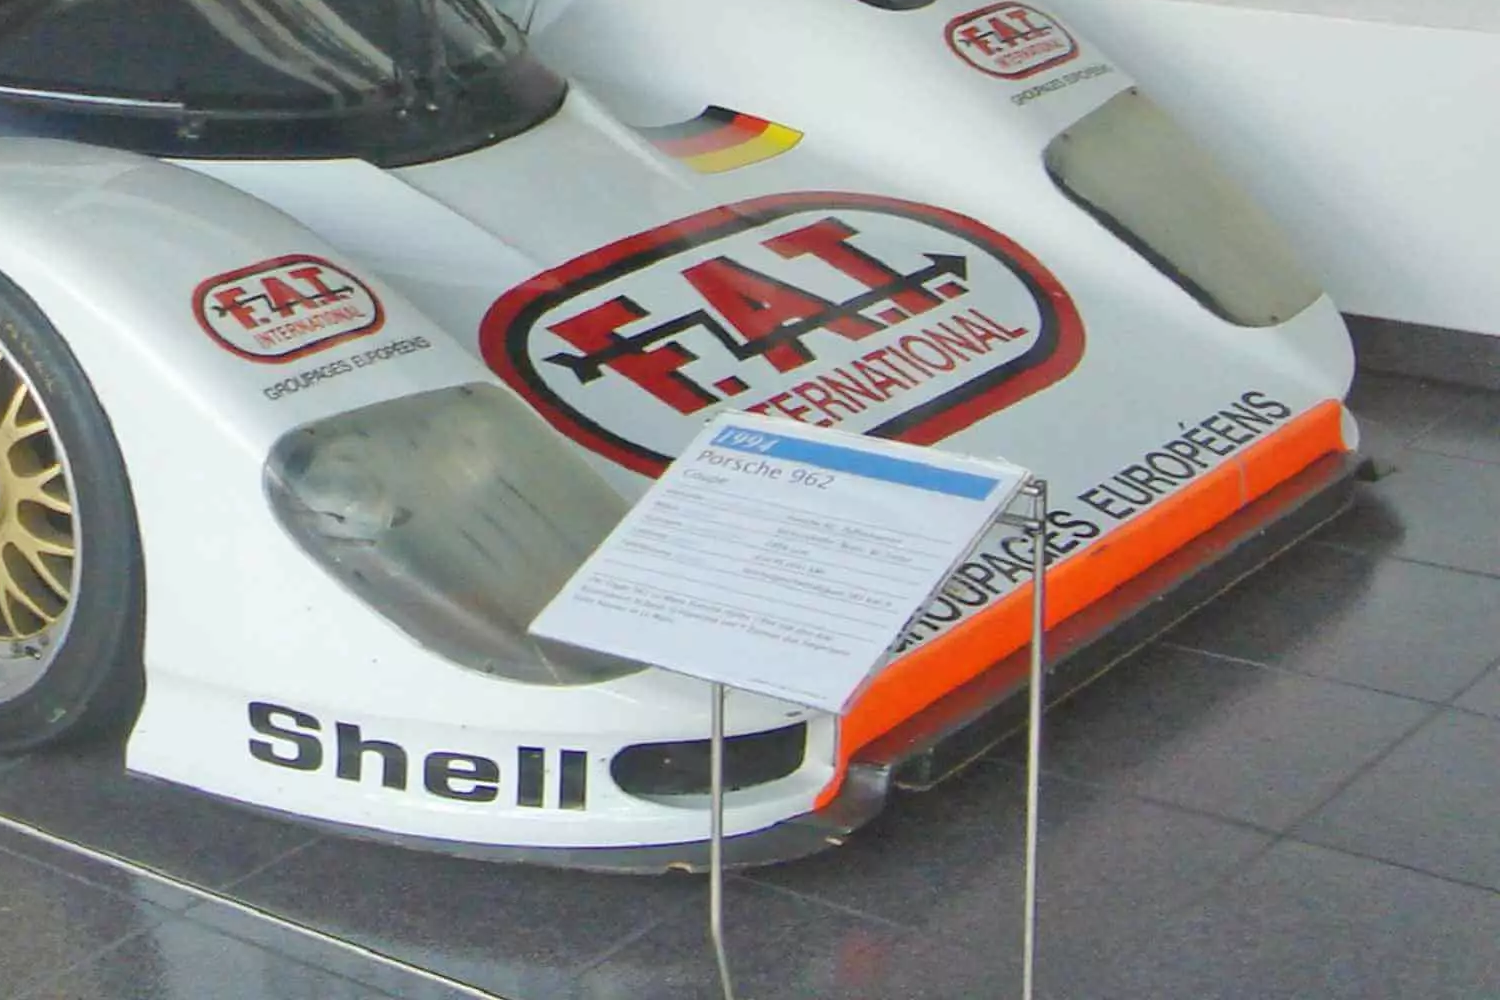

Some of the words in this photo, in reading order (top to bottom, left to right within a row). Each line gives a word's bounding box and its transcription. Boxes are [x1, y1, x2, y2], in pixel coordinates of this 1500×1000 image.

[253, 304, 367, 350] INTERNATIONAL
[263, 359, 353, 401] GROUPAGES
[713, 426, 778, 453] 1994
[1078, 391, 1292, 520] EUROPÉENS
[696, 449, 784, 481] Porsche
[789, 469, 837, 490] 962
[247, 700, 587, 810] Shell
